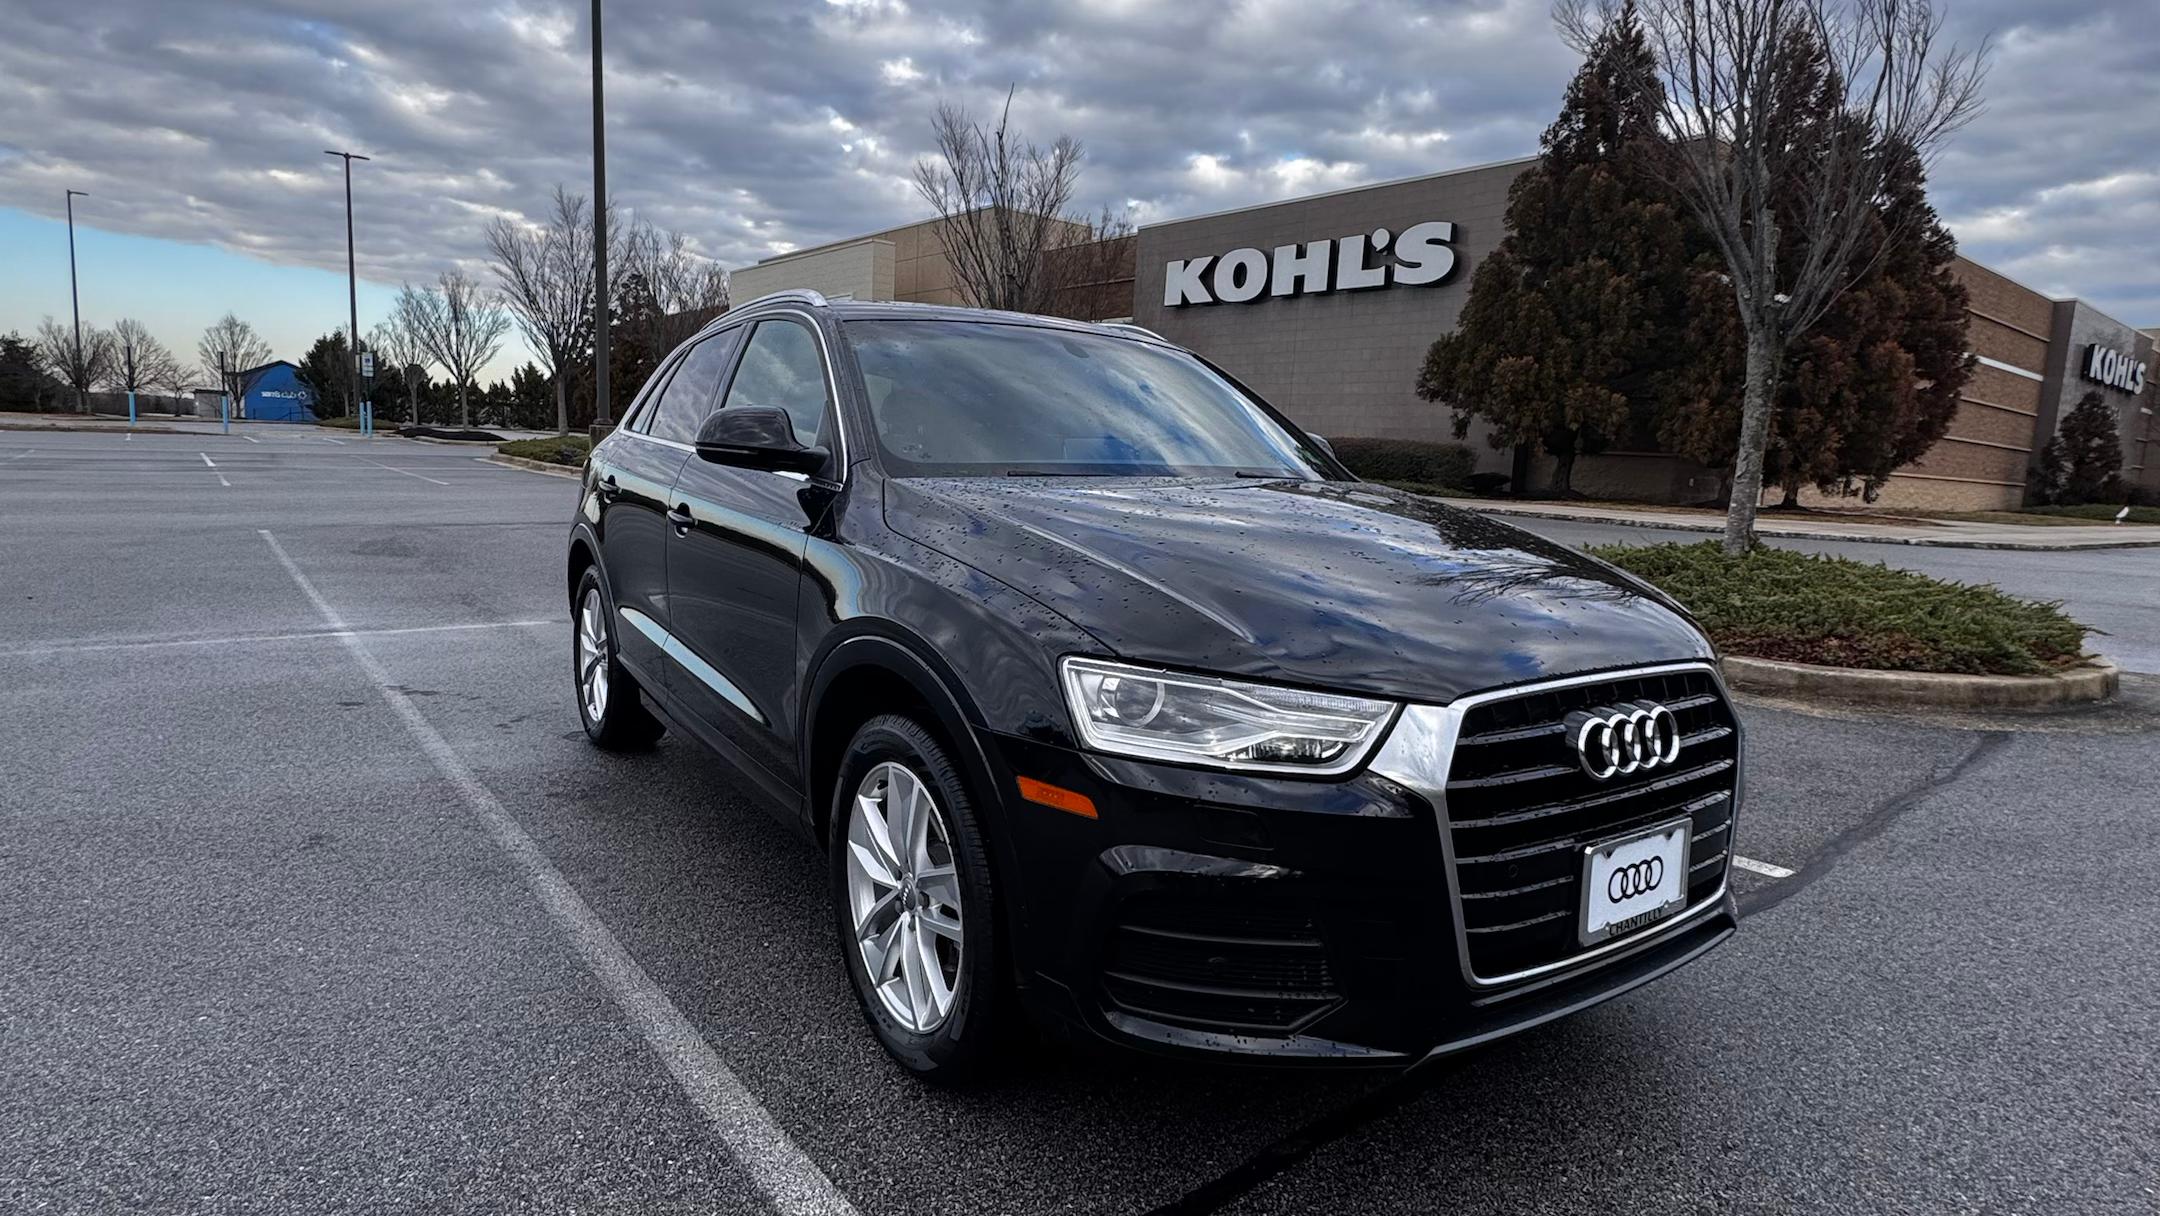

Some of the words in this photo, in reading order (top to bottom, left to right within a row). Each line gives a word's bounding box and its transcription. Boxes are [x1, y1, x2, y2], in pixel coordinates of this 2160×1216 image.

[1164, 221, 1455, 307] KOHL'S
[2089, 344, 2146, 395] KOHL'S
[1609, 907, 1663, 936] CHANTILLY
